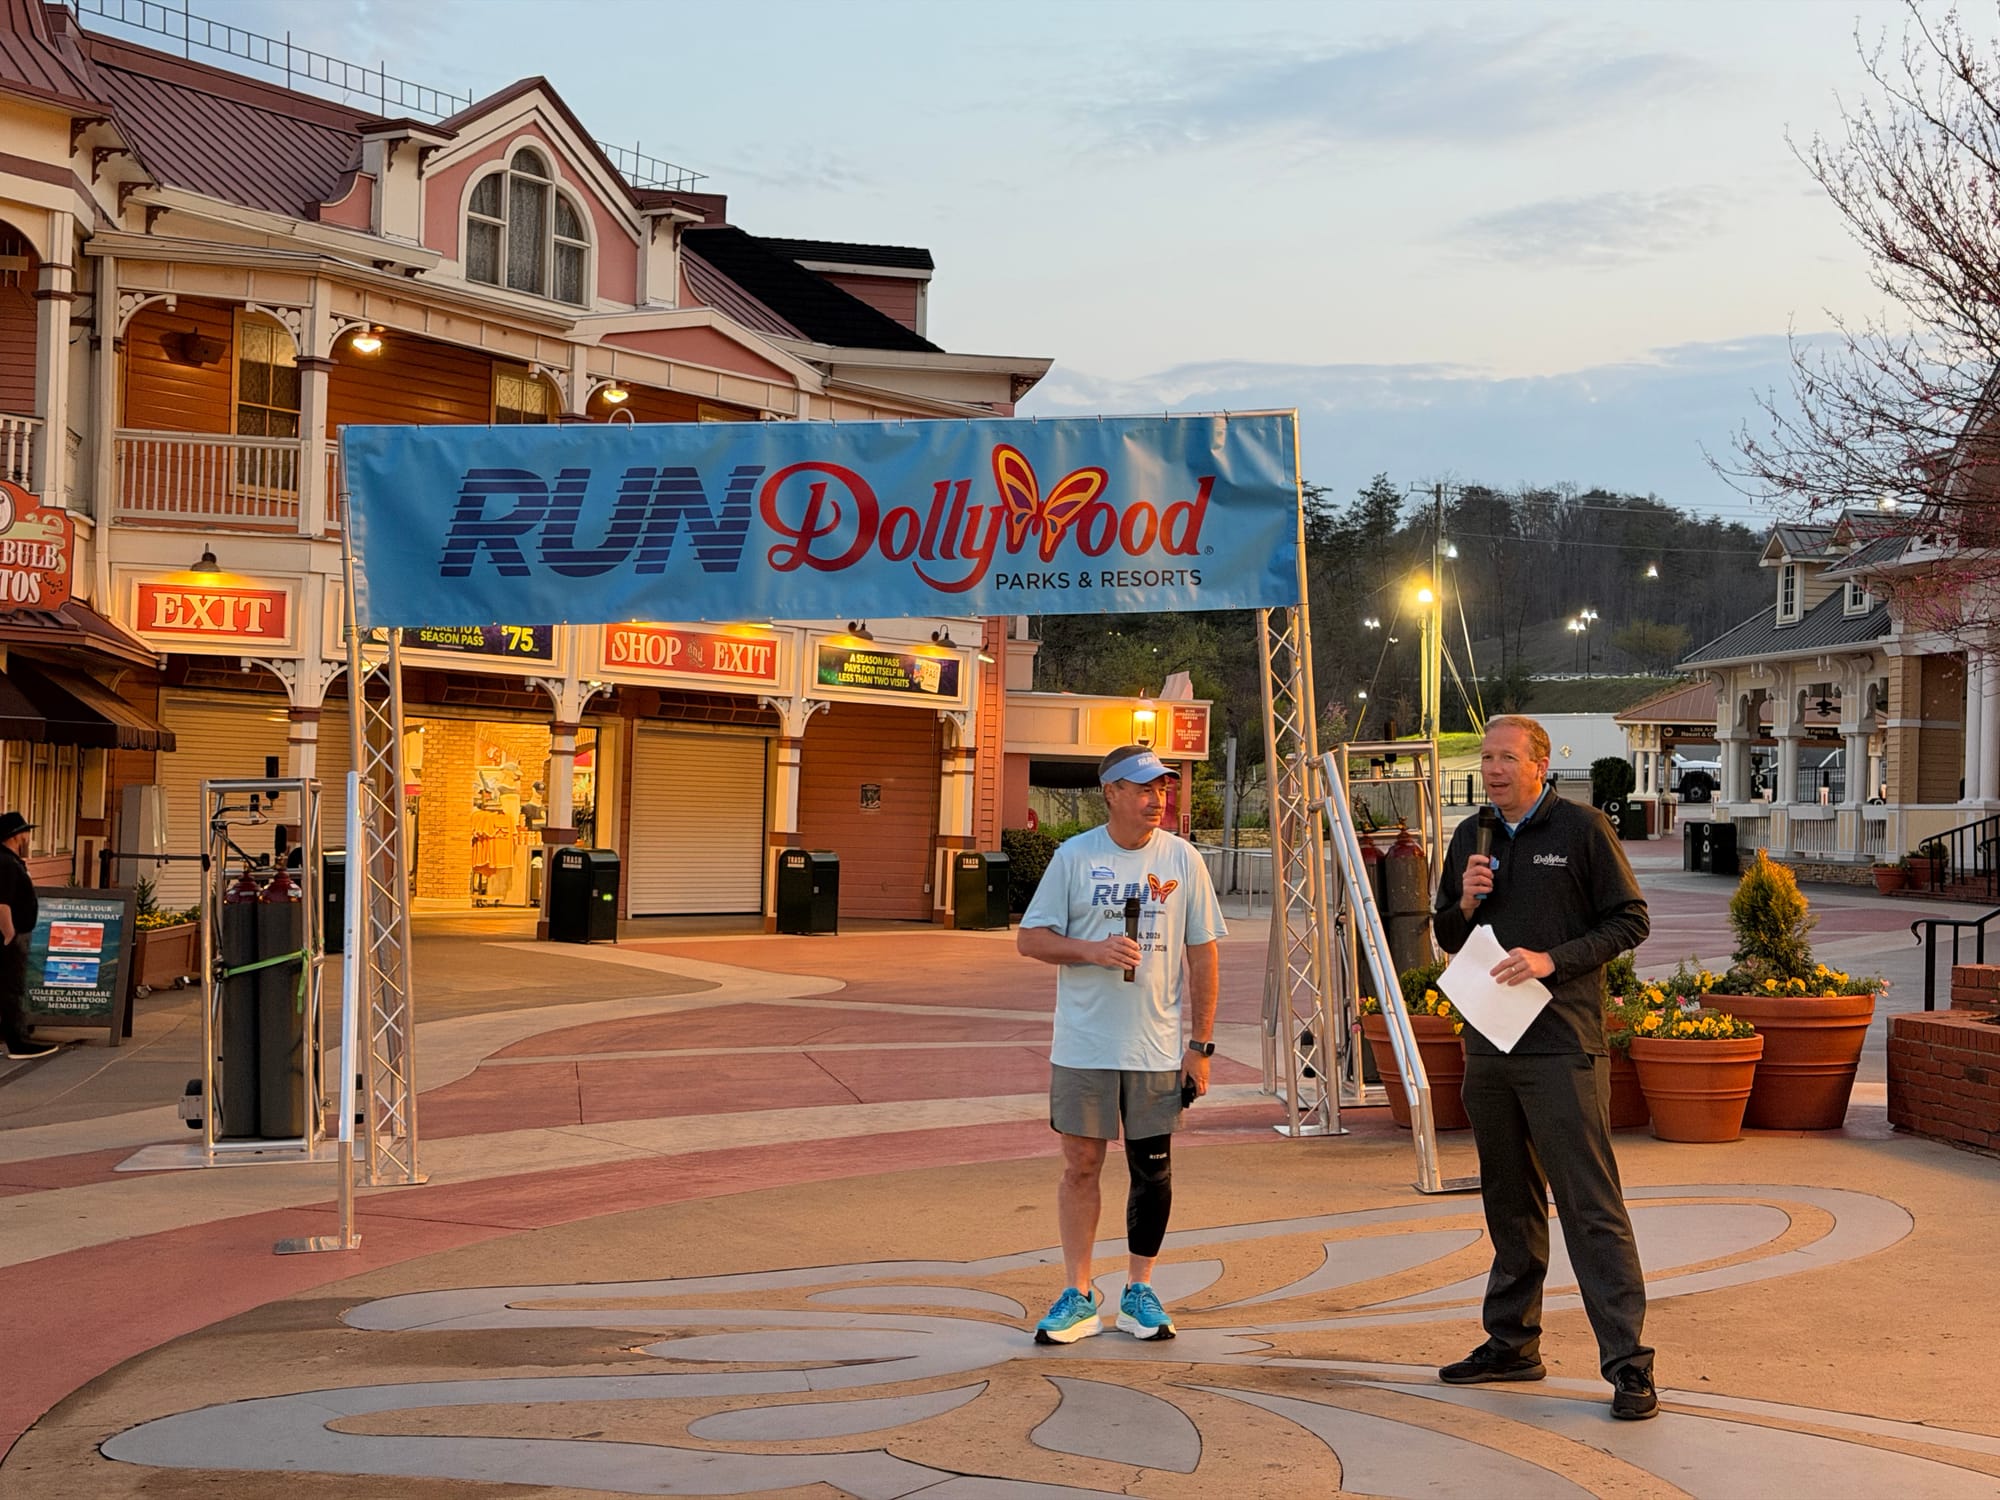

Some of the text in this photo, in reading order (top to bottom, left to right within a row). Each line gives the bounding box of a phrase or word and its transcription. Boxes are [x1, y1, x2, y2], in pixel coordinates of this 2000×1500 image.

[438, 465, 766, 577] RUN
[3, 540, 58, 569] BULB
[995, 569, 1202, 590] PARKS & RESORTS
[151, 592, 272, 633] EXIT
[420, 631, 484, 646] SEASON PASS
[501, 625, 534, 652] $75
[611, 631, 771, 674] SHOP and EXIT
[849, 653, 900, 667] A SEASON PASS
[844, 663, 905, 677] PAYS FOR ITSELF IN
[838, 673, 910, 688] LESS THAN TWO VISITS
[563, 855, 582, 864] TRASH
[1092, 883, 1150, 907] RUN
[94, 913, 121, 921] TODAY
[29, 988, 65, 996] COLLECT
